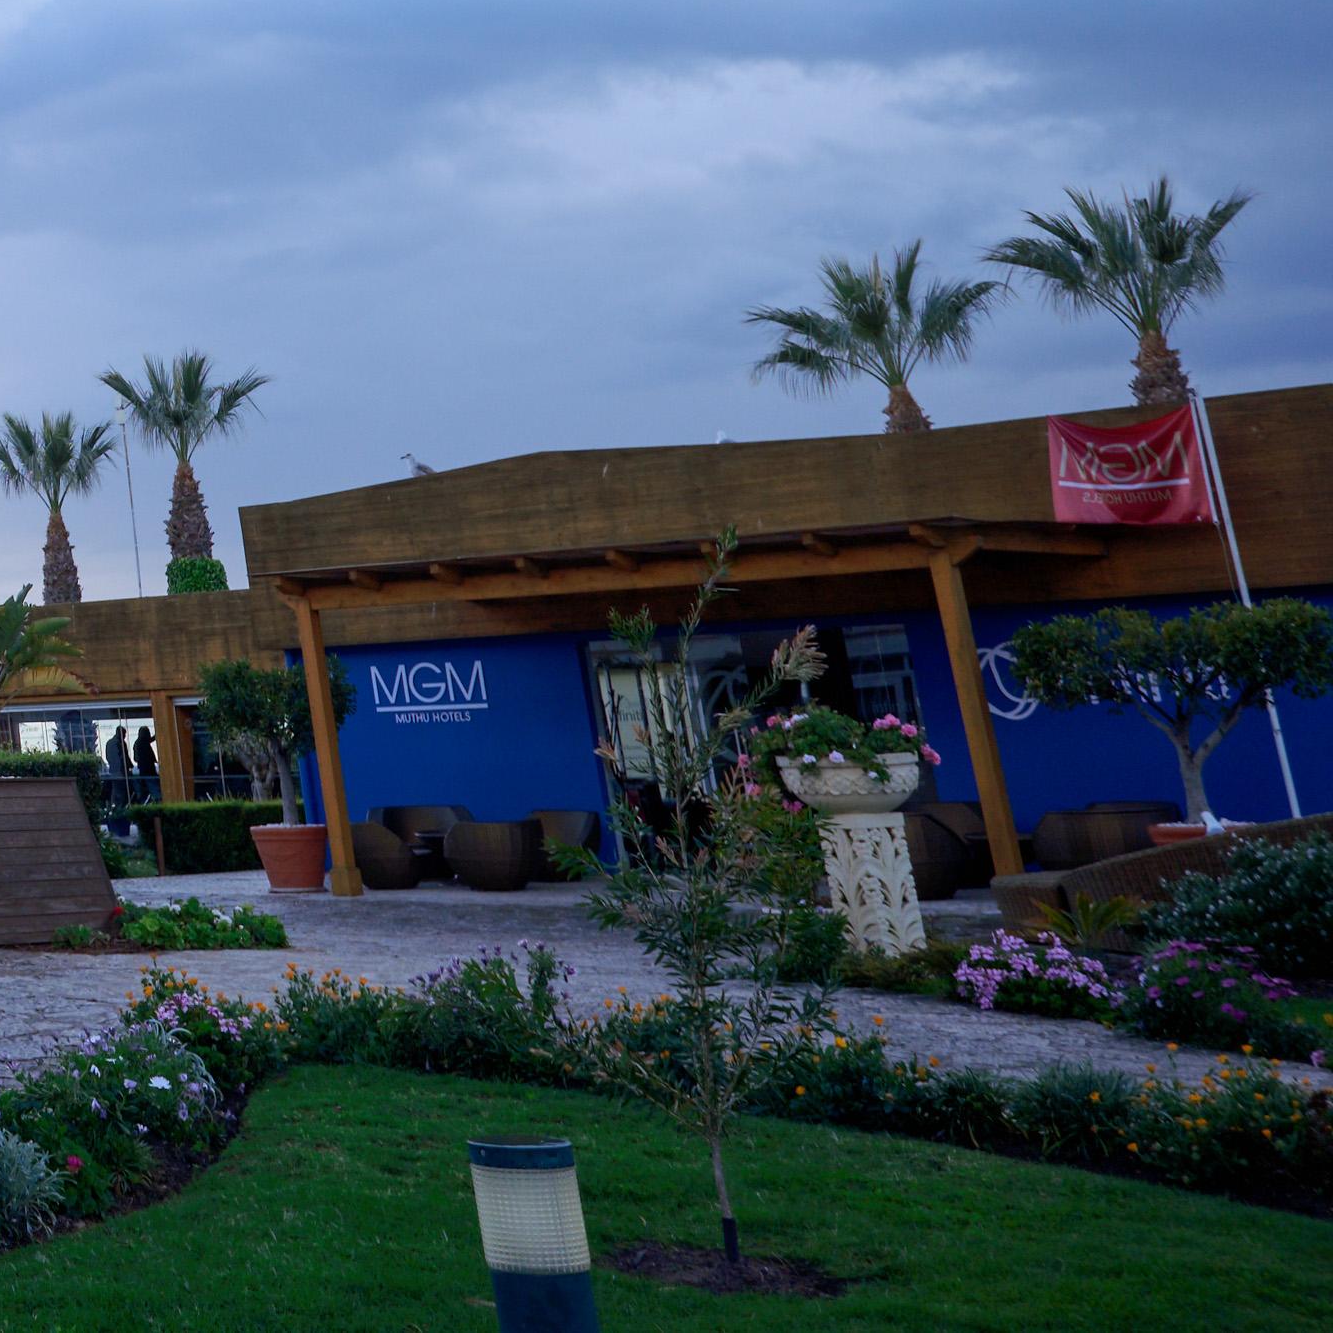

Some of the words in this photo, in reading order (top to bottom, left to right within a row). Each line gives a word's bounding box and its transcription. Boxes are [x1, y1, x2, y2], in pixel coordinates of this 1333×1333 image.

[370, 660, 488, 705] MGM
[395, 712, 430, 724] MUTHU
[433, 710, 471, 723] HOTELS
